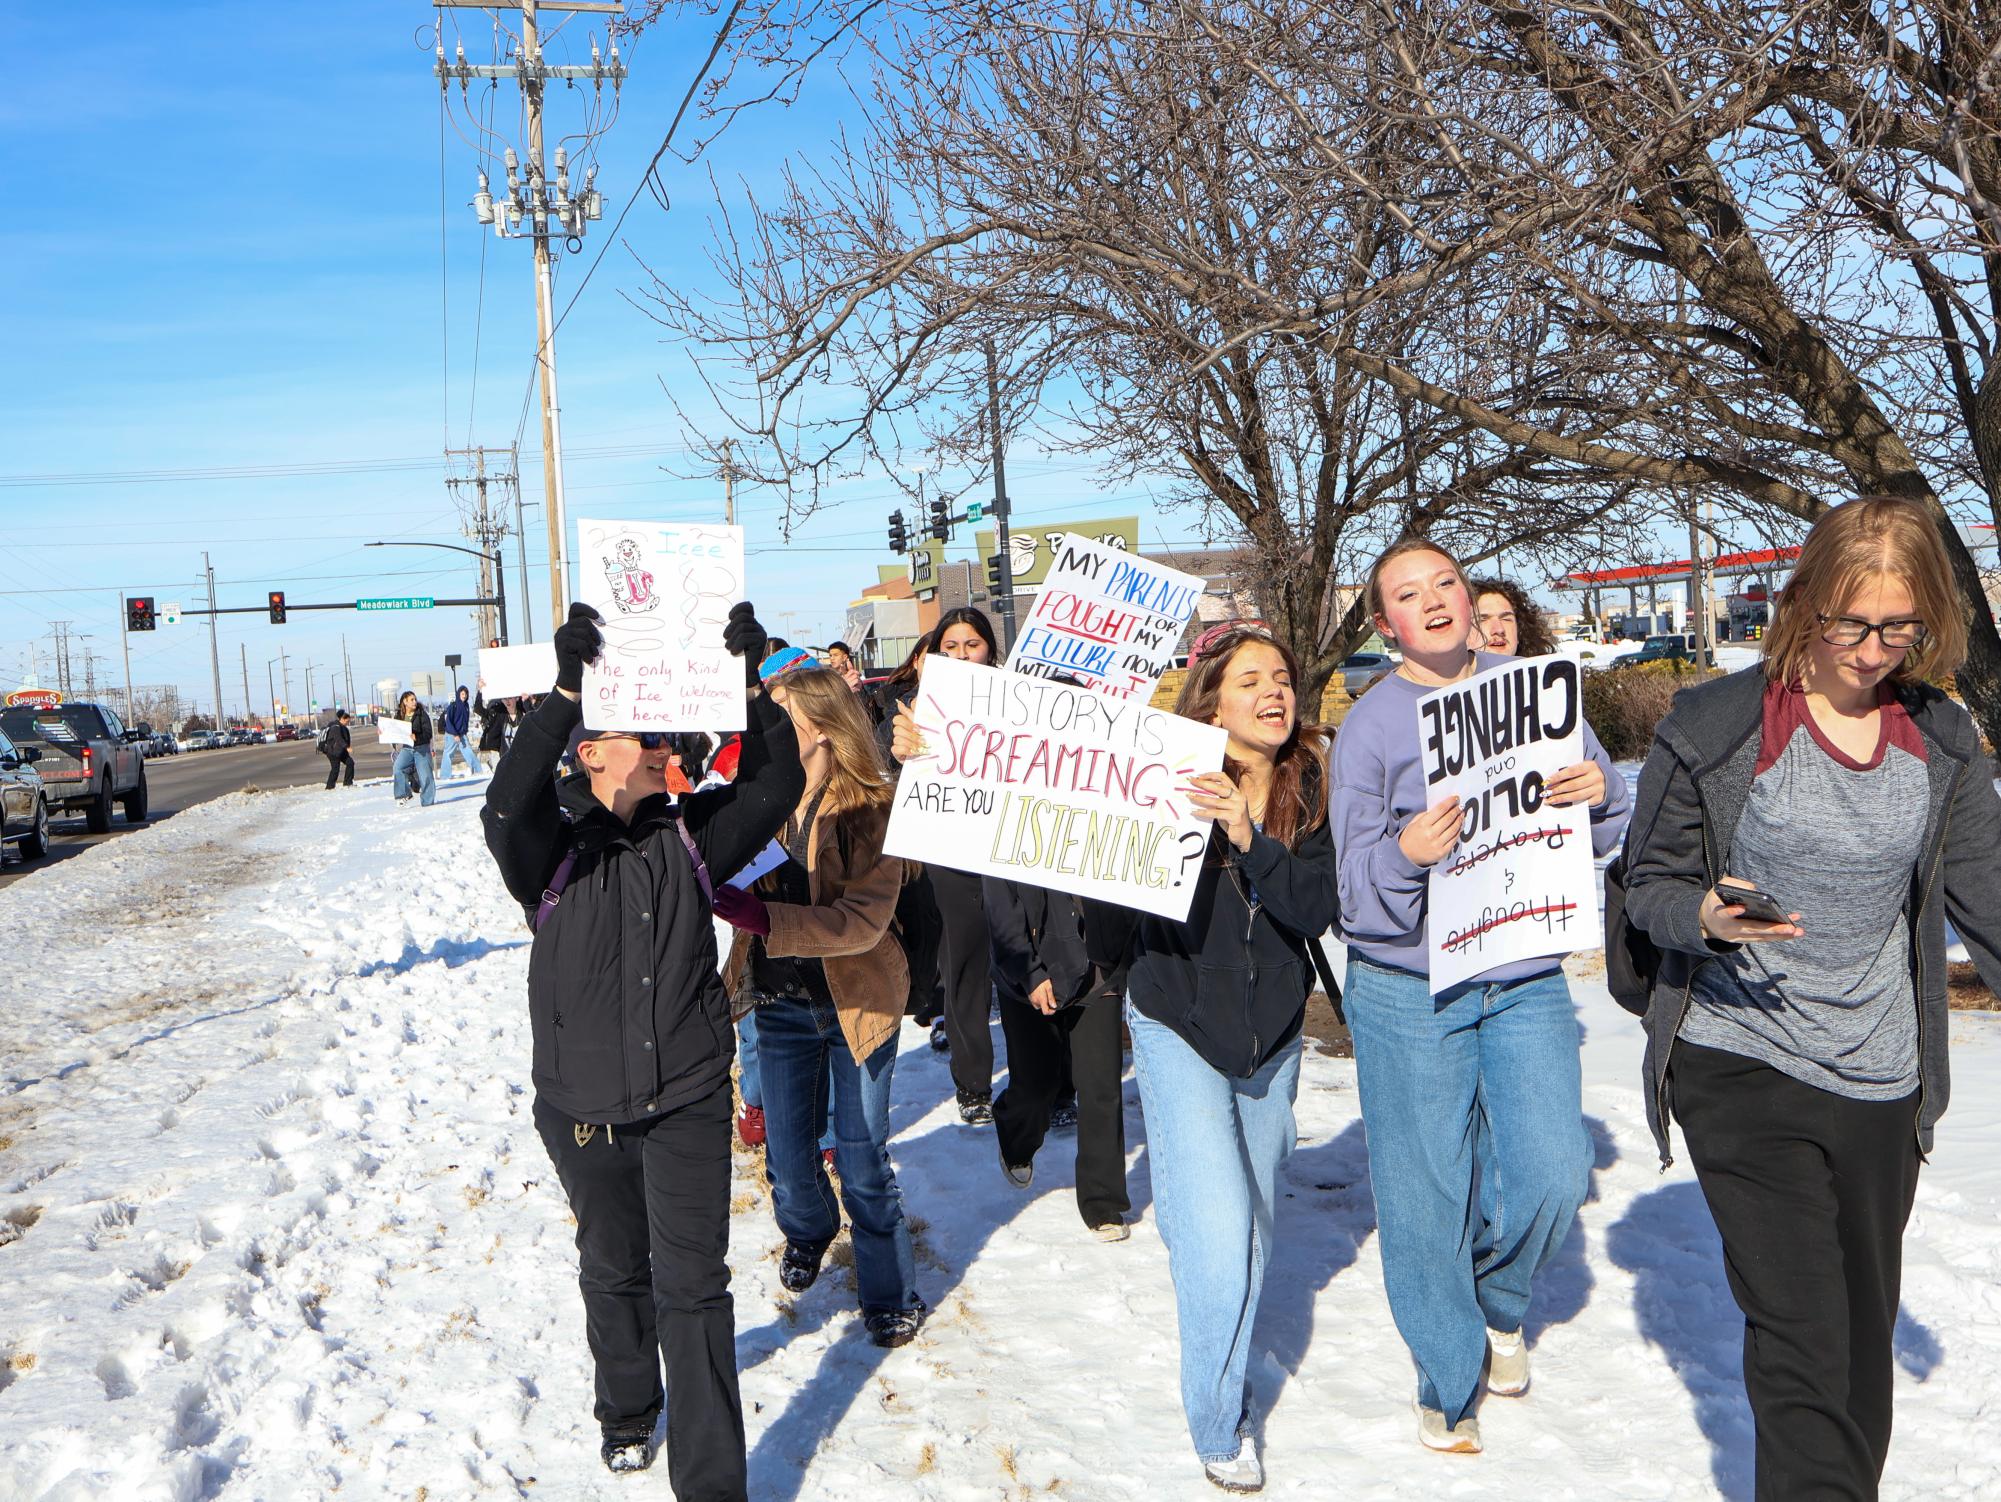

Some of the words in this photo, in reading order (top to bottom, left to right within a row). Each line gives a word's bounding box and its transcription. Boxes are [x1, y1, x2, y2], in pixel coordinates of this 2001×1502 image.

[656, 531, 725, 558] Icee
[1045, 532, 1127, 554] Pra
[360, 599, 409, 609] Meadowlark
[411, 599, 431, 608] Blvd
[1058, 547, 1107, 580] MY
[1104, 561, 1200, 621] PARENTS
[1036, 590, 1142, 642] FOUGHT
[1145, 615, 1177, 636] FOR
[1133, 628, 1163, 650] MY
[592, 656, 625, 677] The
[638, 659, 672, 685] only
[1020, 627, 1121, 674] FUTURE
[633, 705, 672, 722] here
[634, 683, 663, 701] Ice
[970, 674, 1126, 740] HISTORY
[1134, 711, 1167, 755] IS
[1422, 659, 1578, 786] CHANGE
[937, 719, 1169, 809] SCREAMING
[1485, 756, 1516, 784] and
[904, 781, 956, 813] ARE
[963, 788, 995, 815] YOU
[990, 791, 1206, 889] LISTENING?
[1447, 767, 1574, 861] OLIC
[1446, 894, 1575, 955] thoughts
